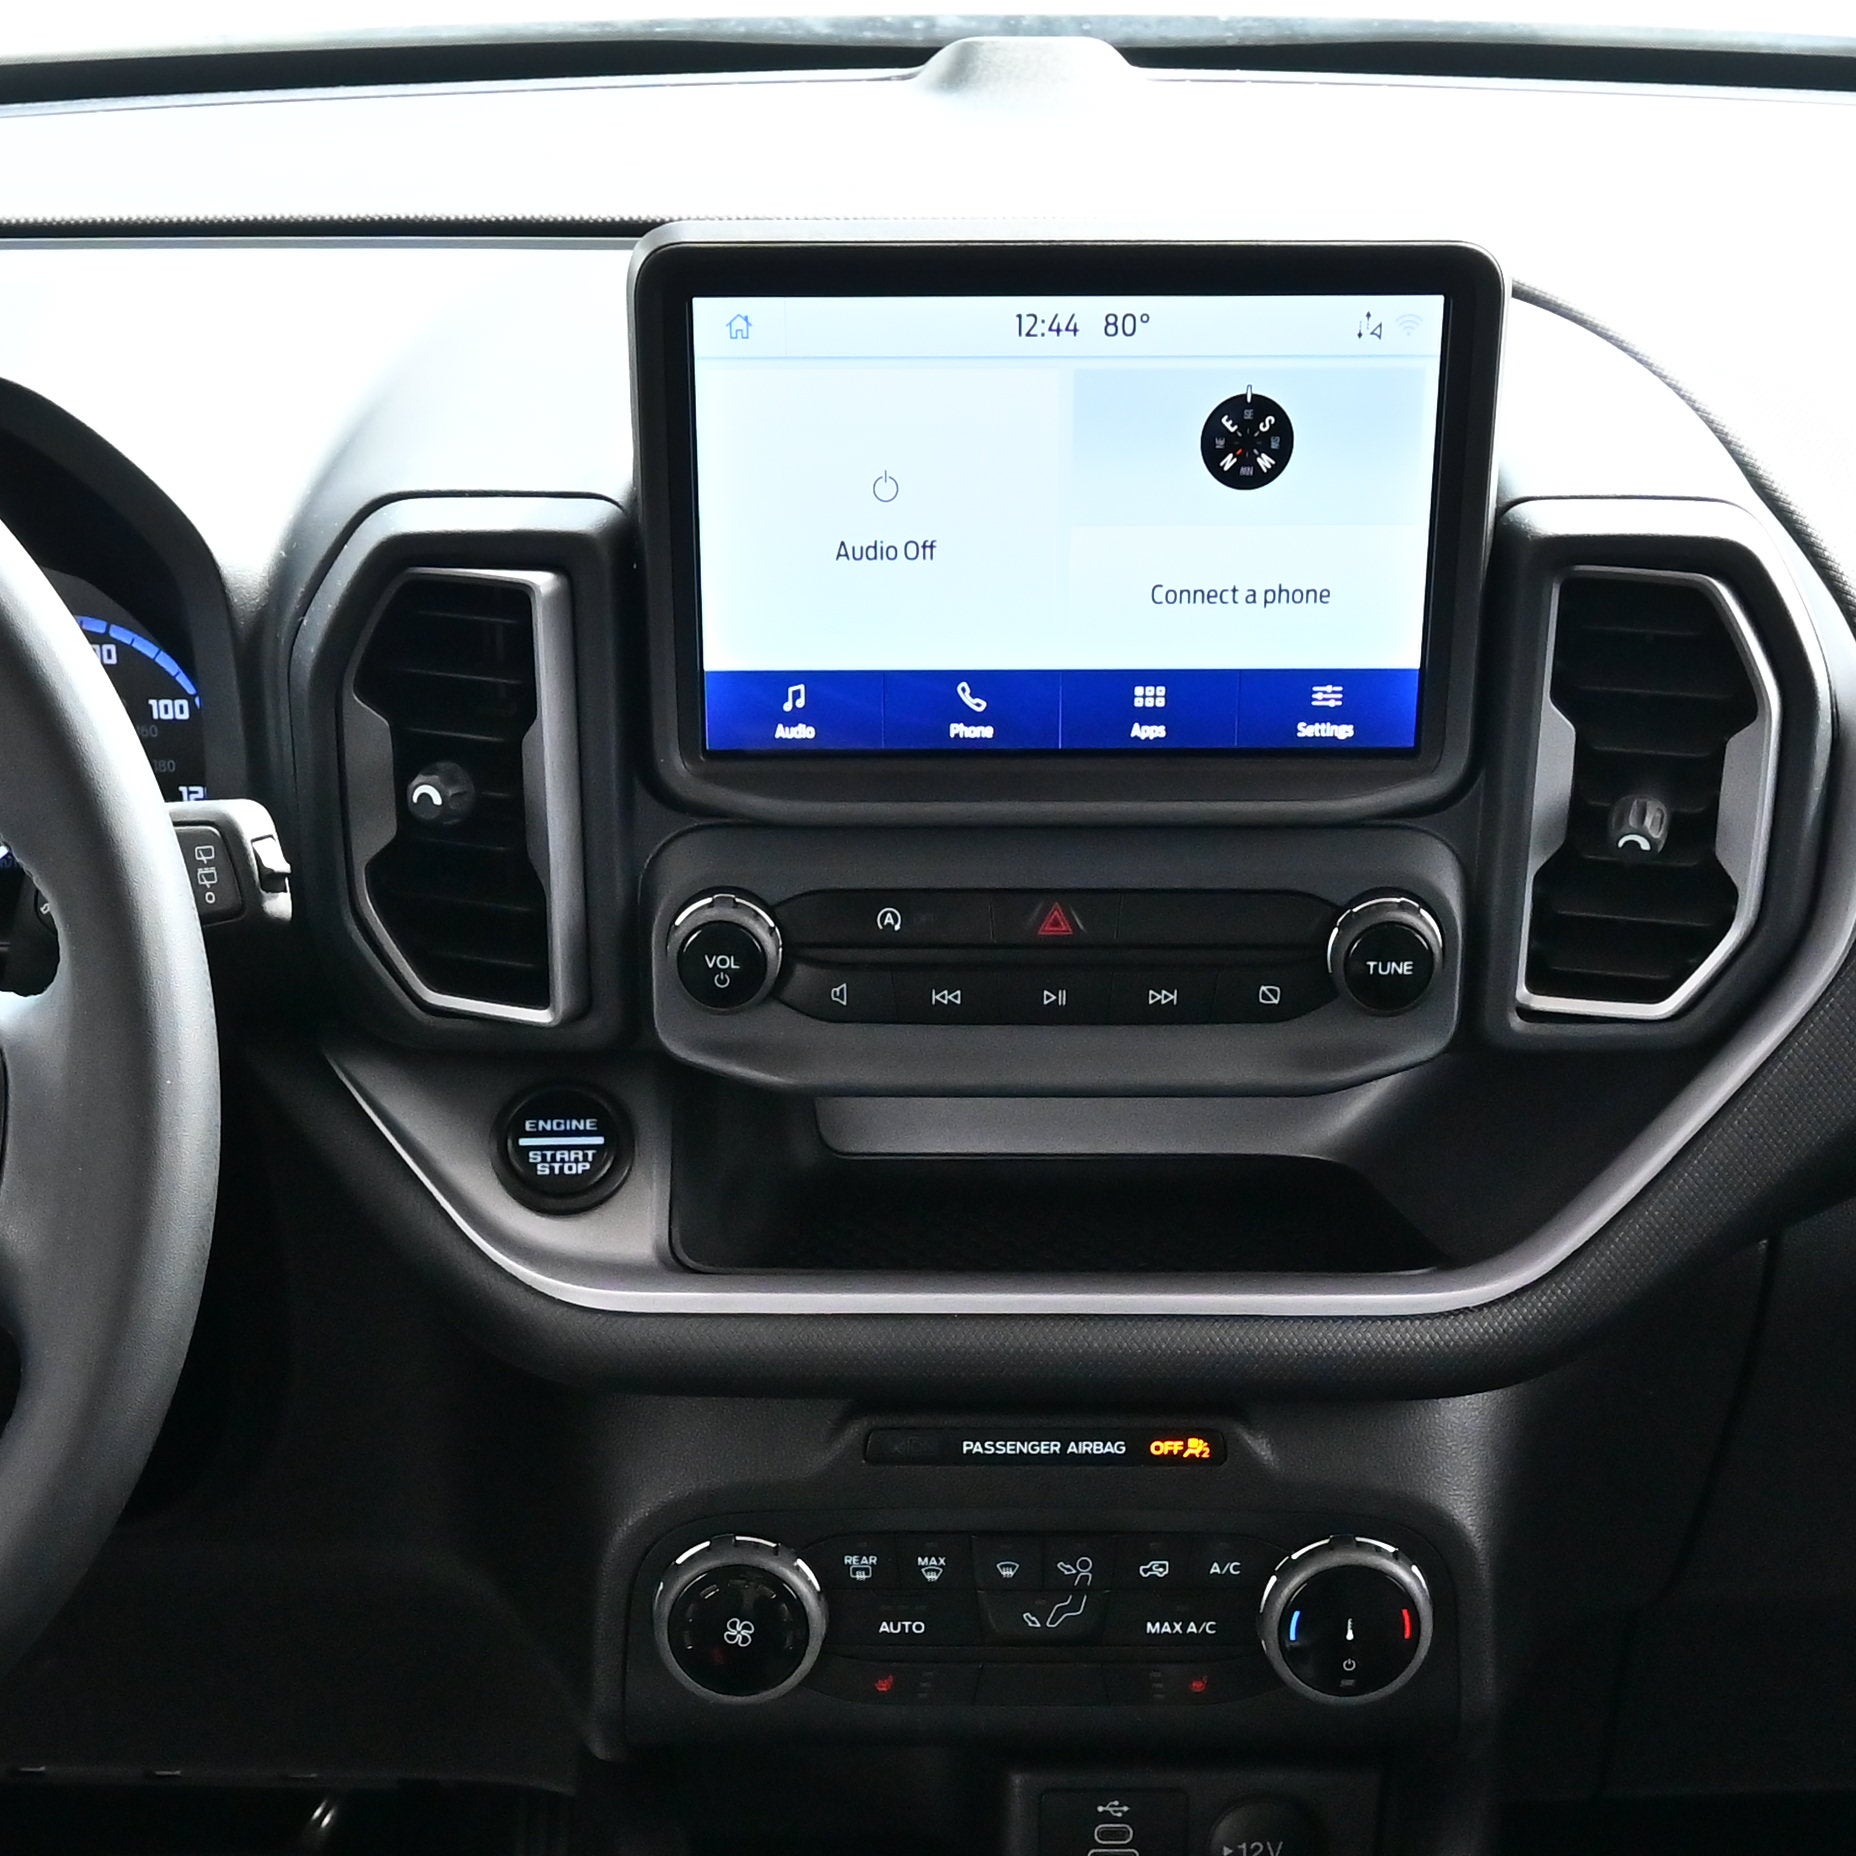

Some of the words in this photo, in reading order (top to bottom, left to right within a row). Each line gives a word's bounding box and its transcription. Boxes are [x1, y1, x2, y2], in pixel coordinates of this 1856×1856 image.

[1014, 312, 1080, 338] 12:44
[1103, 312, 1151, 338] 80°
[1221, 414, 1239, 433] E
[1259, 415, 1276, 432] S
[835, 539, 899, 562] Audio
[903, 538, 937, 562] Off
[1150, 583, 1239, 606] Connect
[1244, 588, 1258, 606] a
[1262, 583, 1332, 609] phone
[147, 698, 190, 721] 100
[774, 722, 816, 740] Audio
[948, 722, 994, 740] Phone
[1130, 722, 1167, 741] Apps
[1296, 721, 1355, 741] Settings
[177, 785, 207, 802] 12
[704, 954, 740, 970] VOL
[1365, 960, 1414, 976] TUNE
[524, 1118, 598, 1132] ENGINE
[528, 1149, 597, 1163] START
[536, 1162, 591, 1175] STOP
[962, 1440, 1062, 1455] PASSENGER
[1066, 1440, 1127, 1455] AIRBAG
[1149, 1440, 1184, 1457] OFF
[844, 1555, 878, 1566] REAR
[917, 1556, 946, 1567] MAX
[1209, 1561, 1242, 1577] A/C
[878, 1620, 926, 1635] AUTO
[1146, 1621, 1183, 1635] MAX
[1186, 1621, 1217, 1635] A/C
